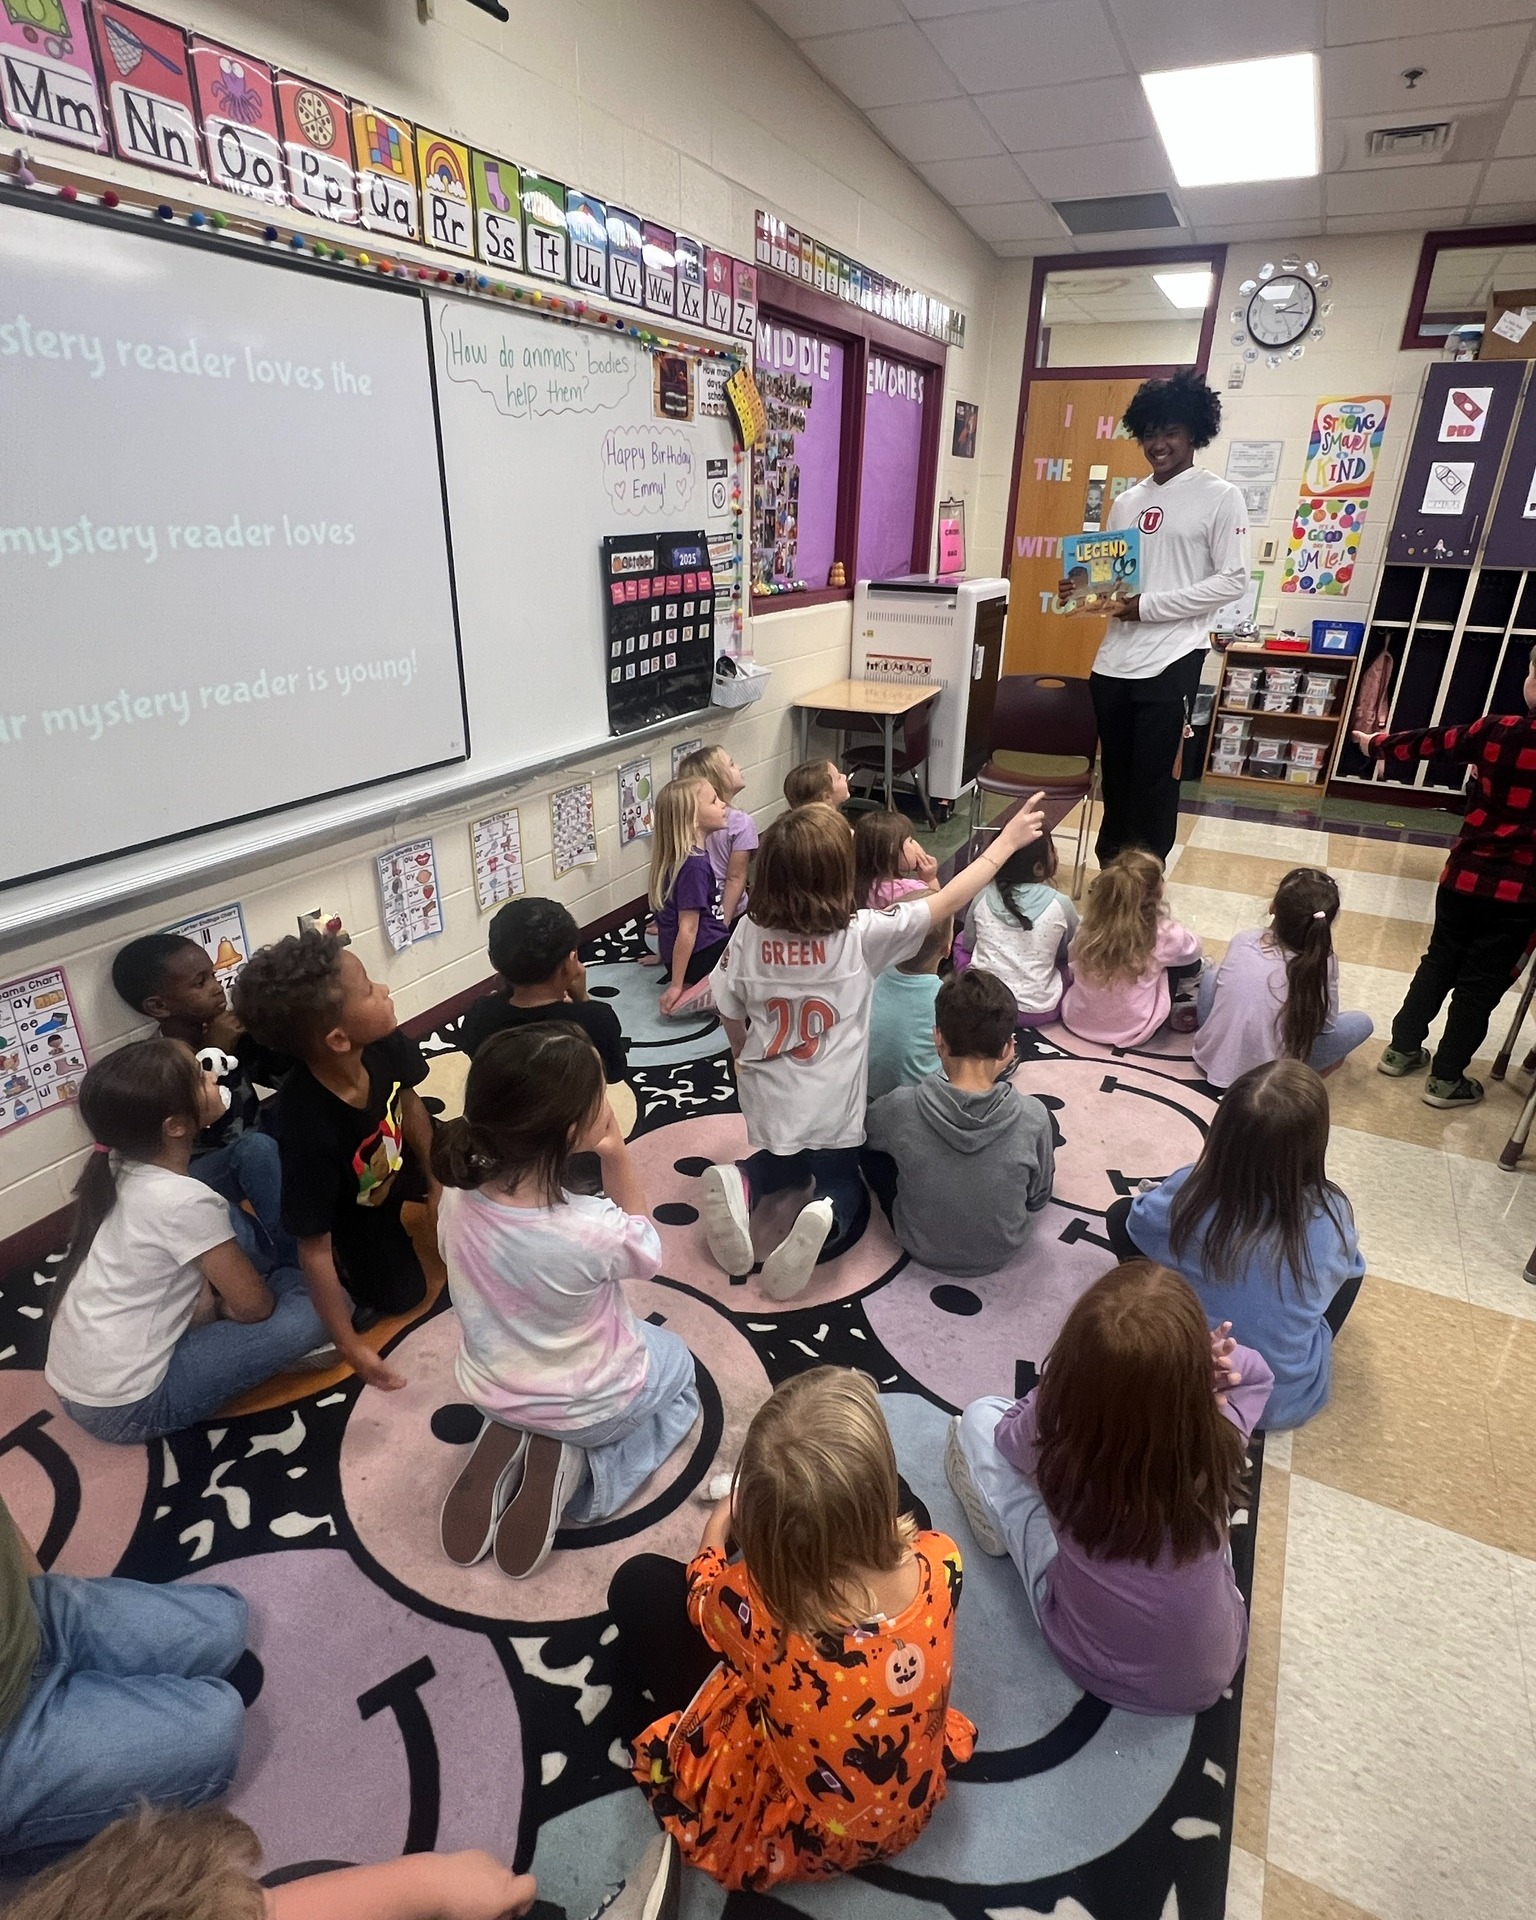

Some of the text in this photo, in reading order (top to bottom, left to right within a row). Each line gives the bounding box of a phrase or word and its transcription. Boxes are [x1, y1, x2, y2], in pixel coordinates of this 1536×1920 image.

[4, 56, 753, 336] Mm Nn Oo Pp Qq Rr Ss Tt Uu Vv Ww Xx Yy Zz
[450, 329, 488, 367] How
[499, 336, 515, 369] do
[587, 350, 630, 376] bodies
[116, 338, 236, 379] reader
[245, 346, 324, 391] loves
[331, 361, 373, 396] the
[703, 365, 716, 375] How
[505, 375, 590, 420] help them?
[708, 391, 725, 401] schoo
[1065, 404, 1073, 427] I
[1323, 414, 1375, 433] STRONG
[606, 437, 646, 473] Happy
[651, 441, 692, 473] Birthday
[1034, 458, 1072, 482] THE
[1314, 457, 1366, 487] KIND
[632, 473, 667, 509] Emmy!
[167, 514, 275, 550] reader
[283, 514, 356, 547] loves
[1143, 512, 1161, 530] U
[1308, 529, 1343, 543] GOOD
[679, 553, 697, 566] 2025
[1076, 540, 1127, 562] LEGEND
[42, 688, 190, 741] mystery
[199, 668, 299, 710] reader
[306, 665, 328, 692] is
[335, 648, 418, 696] young!
[761, 940, 826, 966] GREEN
[28, 974, 60, 989] Chart
[13, 995, 32, 1008] ay
[20, 1019, 39, 1031] ee
[33, 1063, 52, 1076] oe
